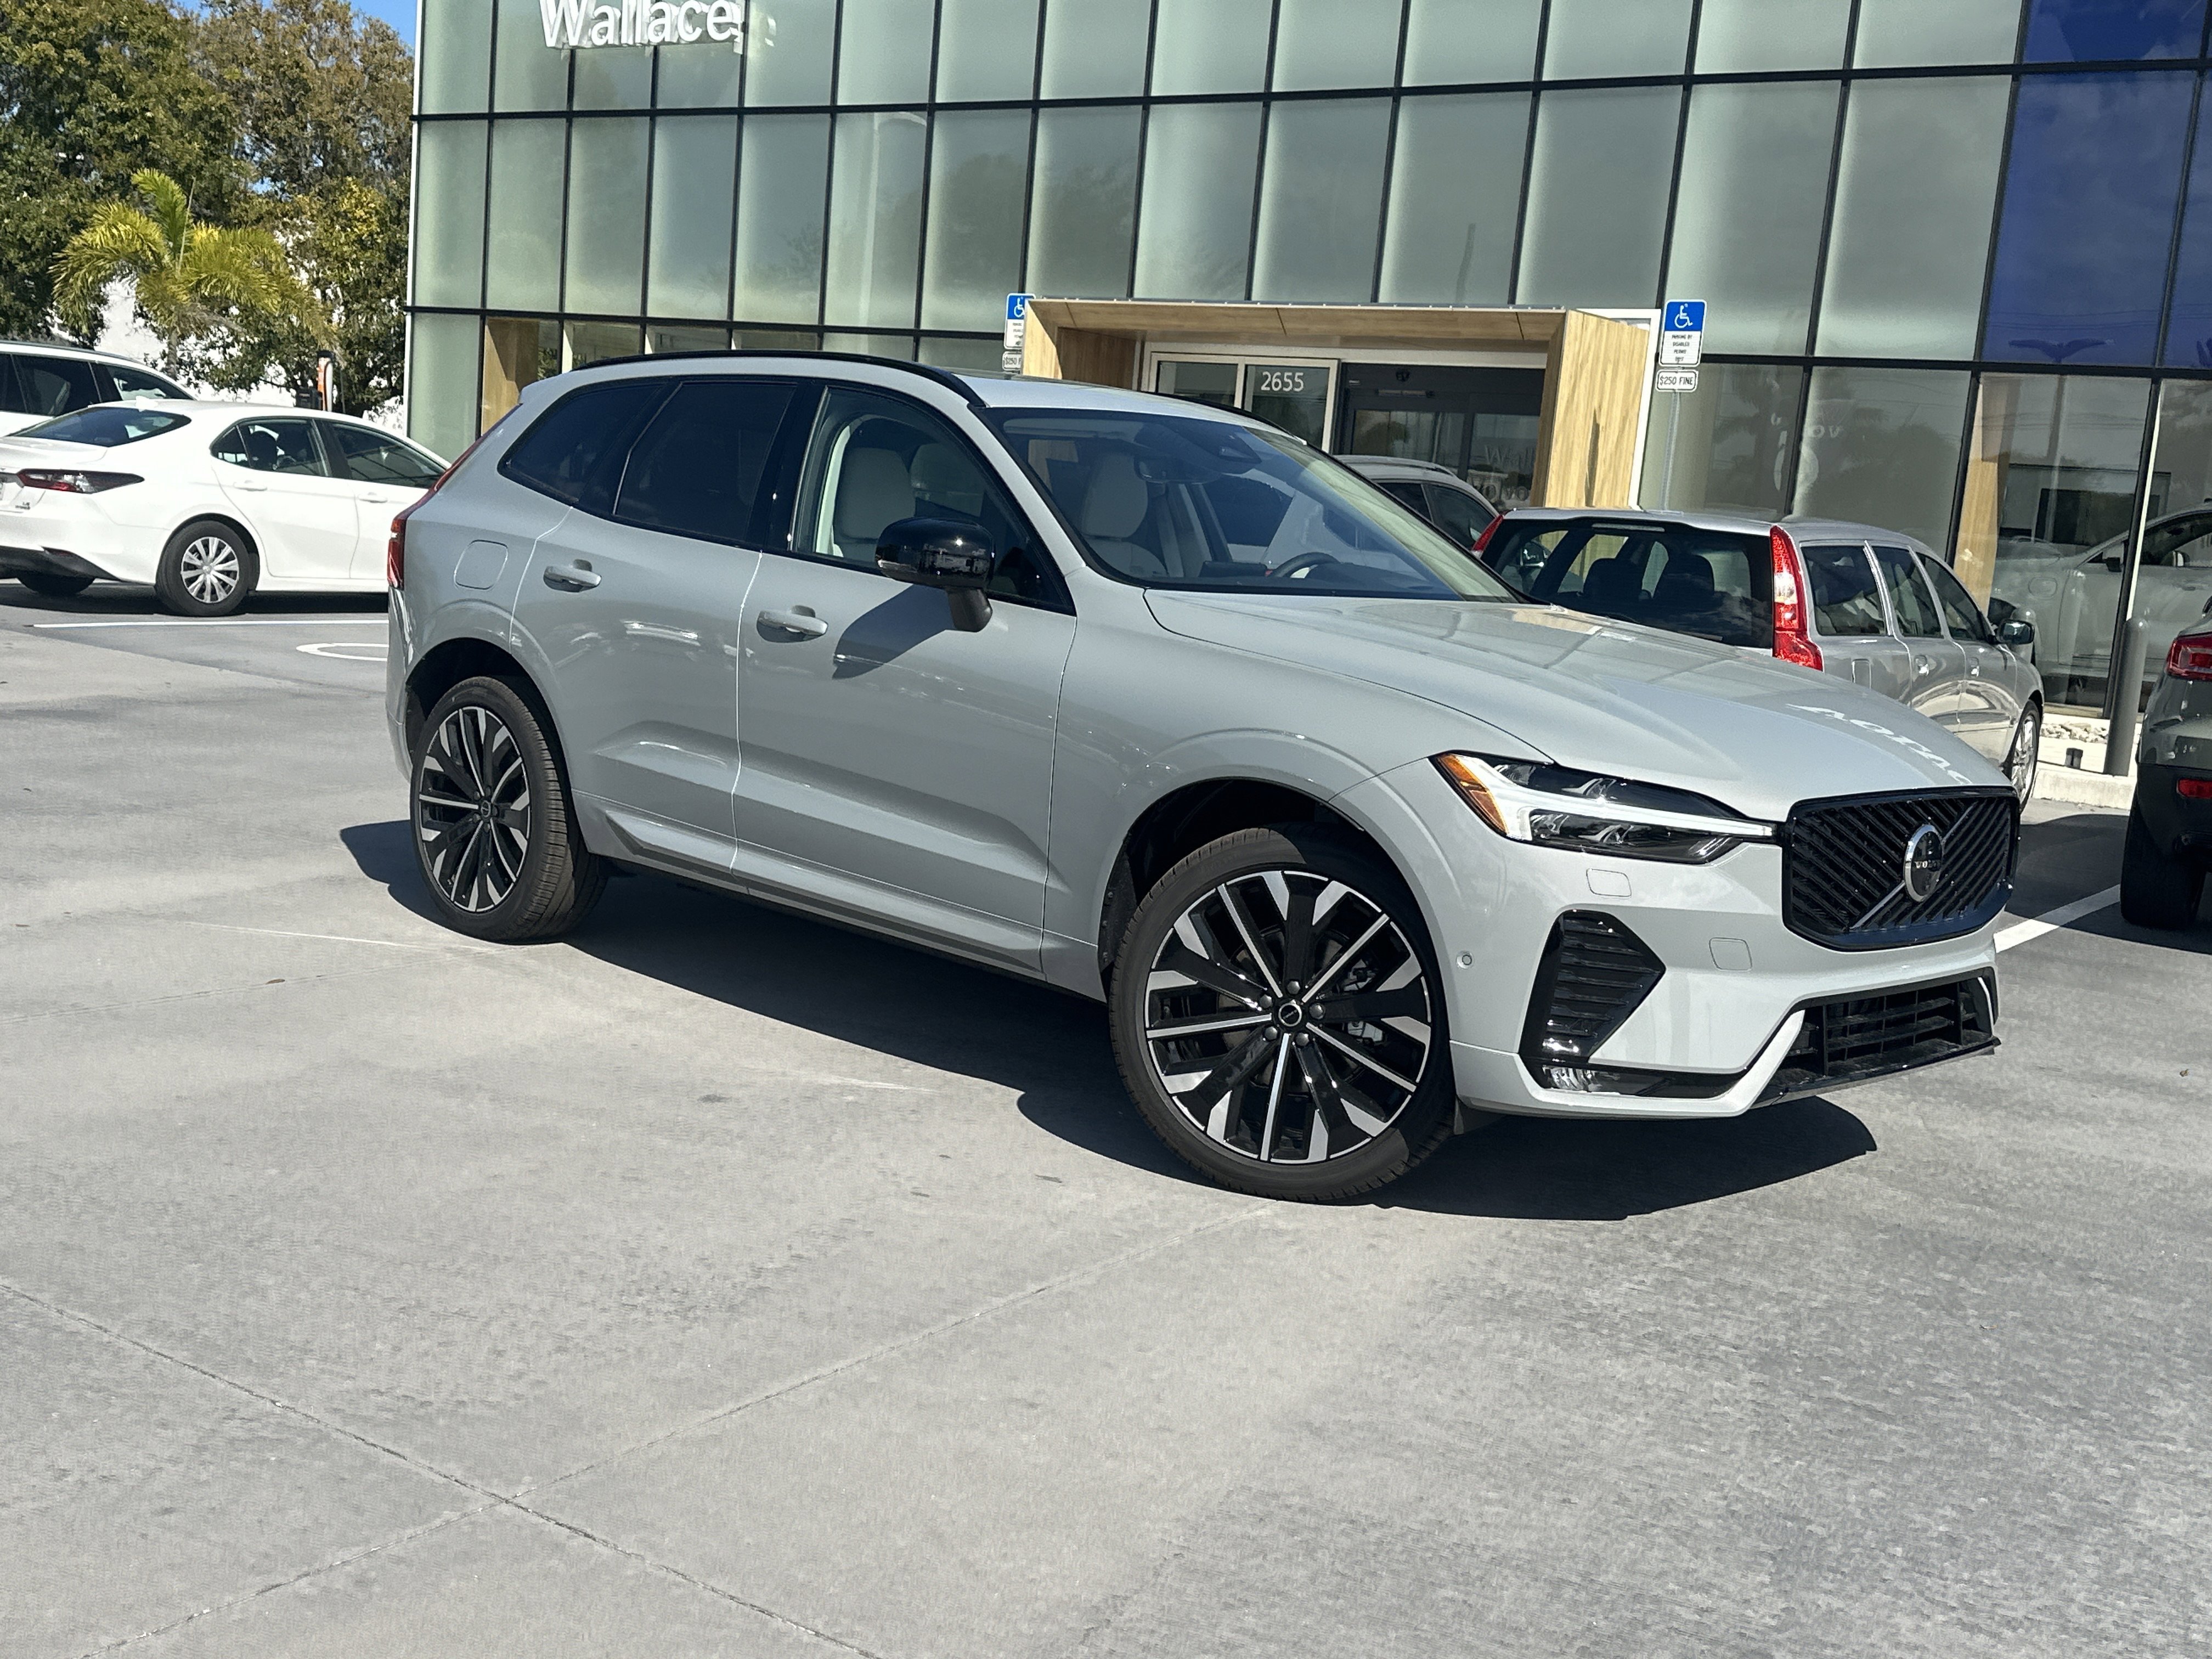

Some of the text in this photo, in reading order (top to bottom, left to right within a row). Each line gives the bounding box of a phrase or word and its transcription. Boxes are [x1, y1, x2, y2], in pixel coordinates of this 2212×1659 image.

[540, 0, 735, 48] Wallace
[1261, 371, 1304, 392] 2655
[1660, 375, 1693, 386] $250 FINE
